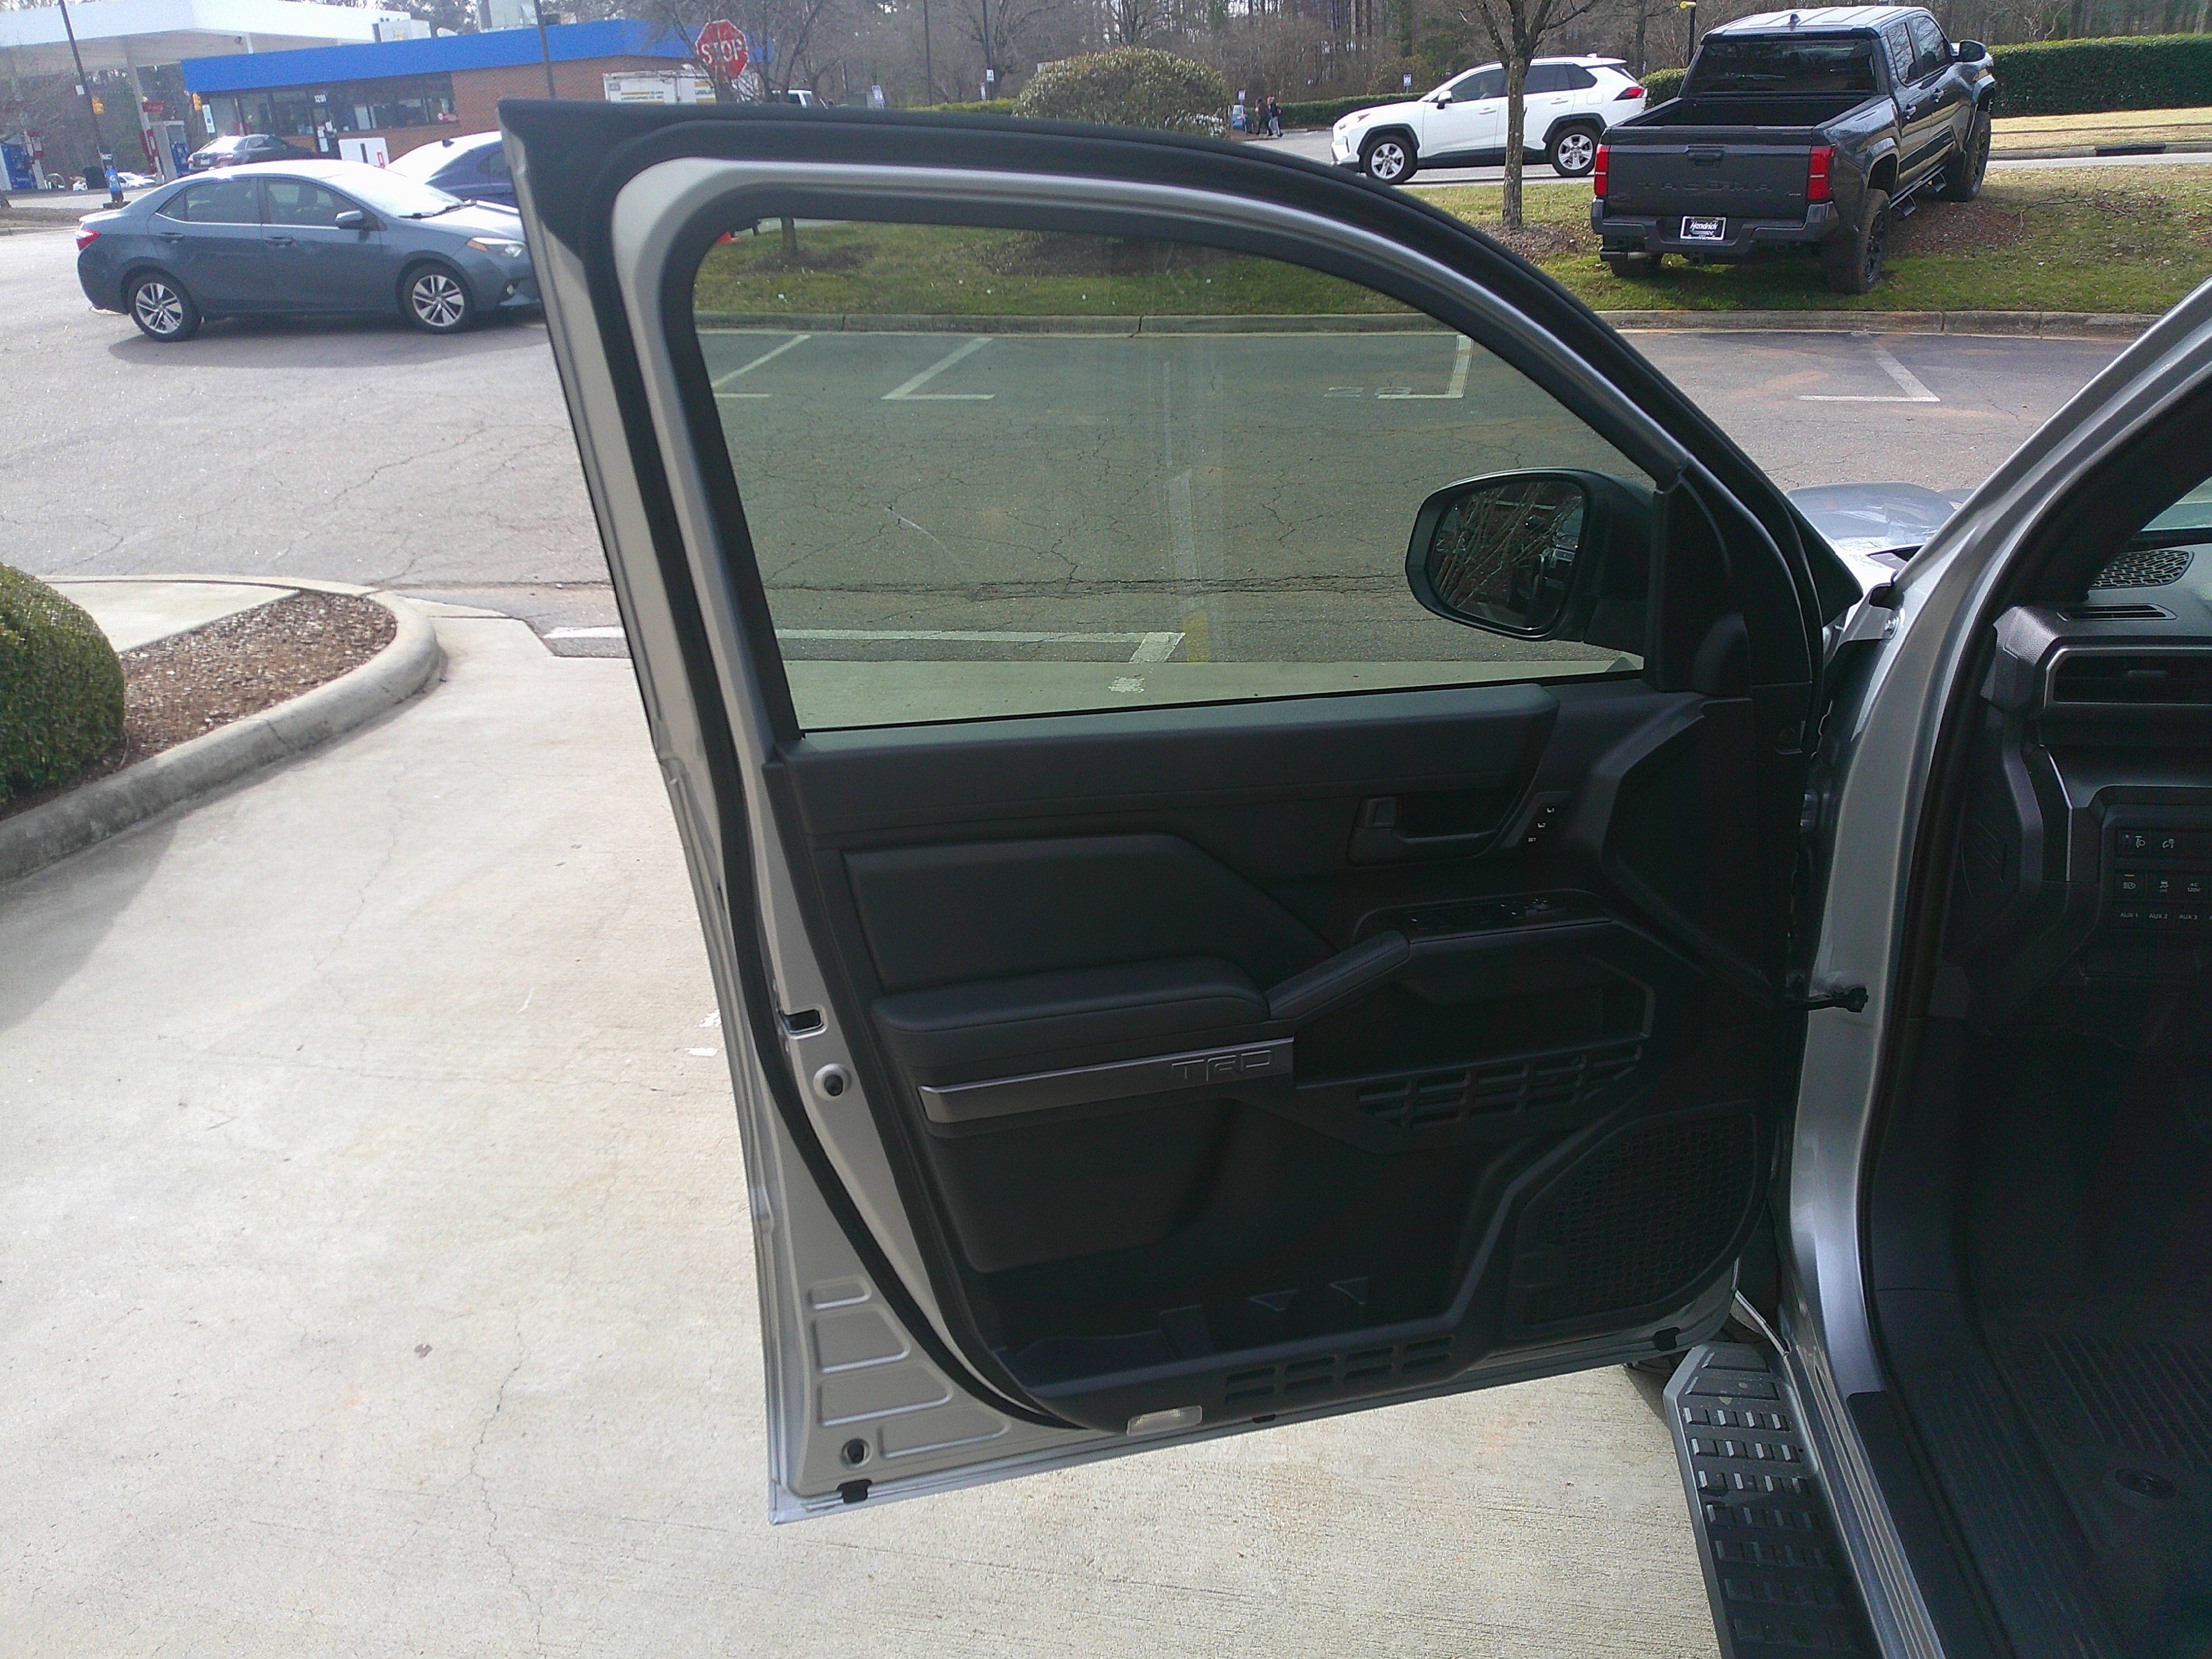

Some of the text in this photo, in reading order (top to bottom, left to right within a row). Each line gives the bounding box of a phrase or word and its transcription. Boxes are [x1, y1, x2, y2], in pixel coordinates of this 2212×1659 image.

[700, 39, 742, 64] STOP
[314, 94, 326, 102] 1201
[1638, 181, 1772, 192] TACOMA
[1689, 221, 1719, 231] Hendrick
[1171, 1050, 1271, 1082] TRD
